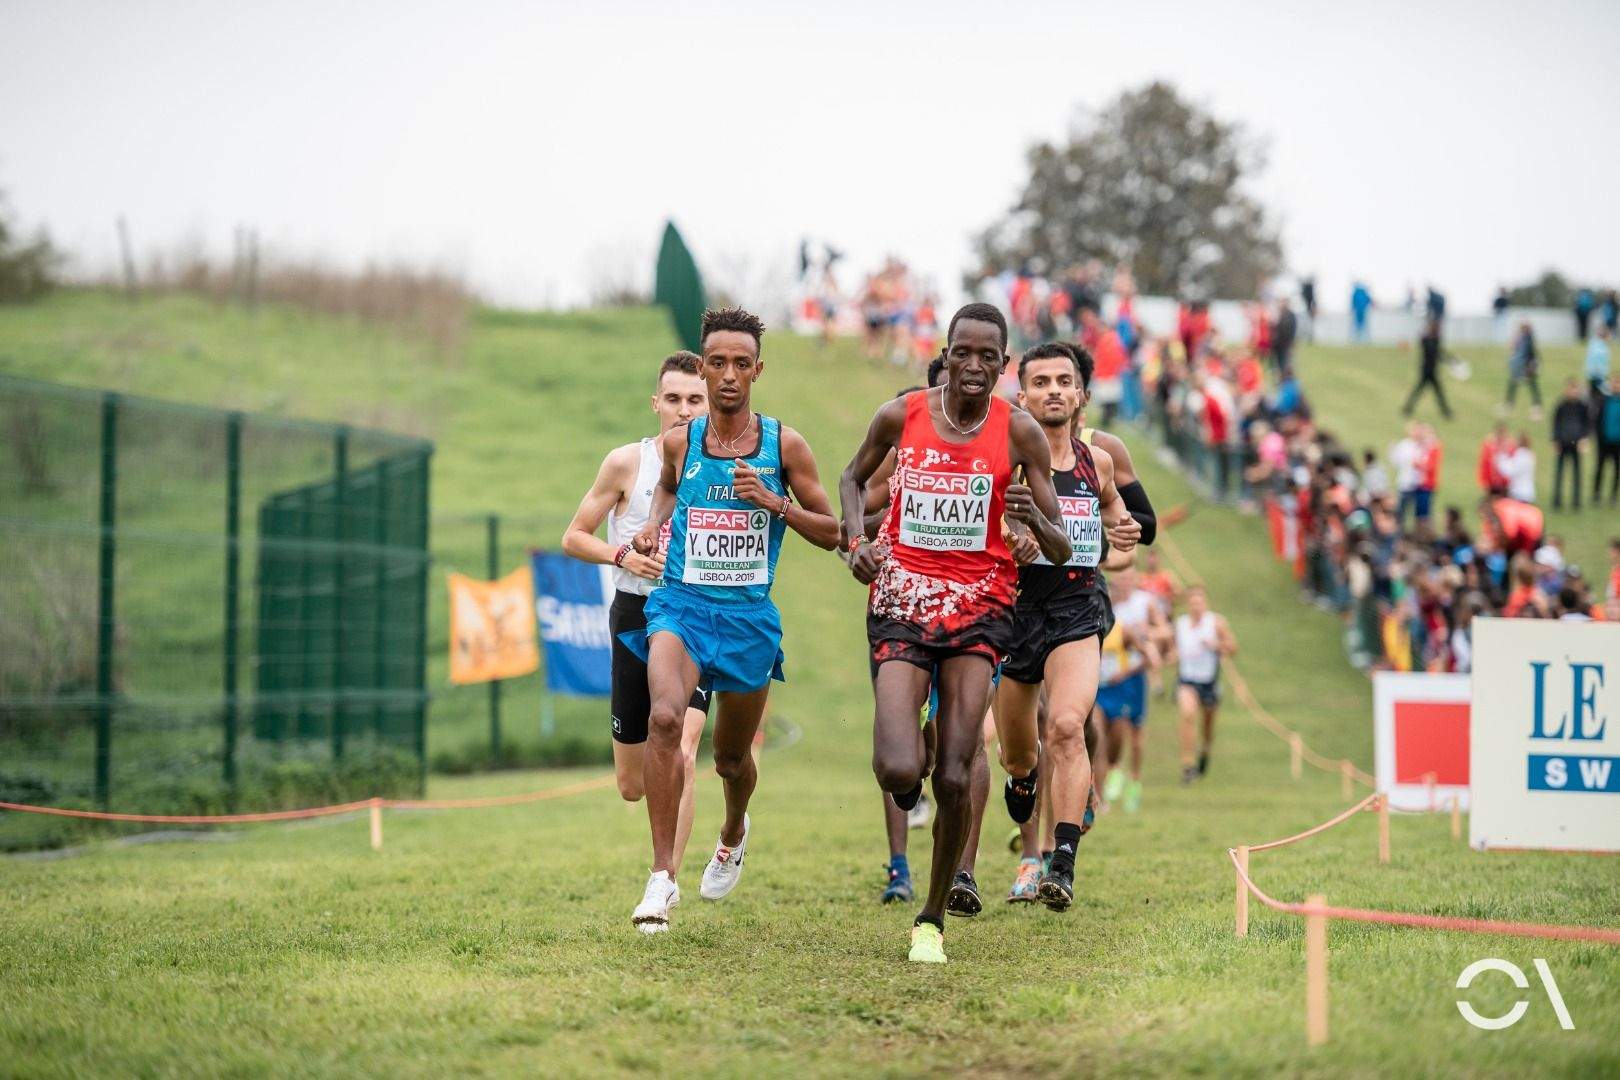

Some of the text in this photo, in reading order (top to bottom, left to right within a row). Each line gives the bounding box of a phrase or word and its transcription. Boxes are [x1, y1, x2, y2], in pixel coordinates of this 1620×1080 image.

[904, 473, 968, 494] SPAR
[706, 485, 739, 501] ITAL
[904, 494, 985, 524] Ar. KAYA
[689, 511, 747, 528] SPAR
[920, 525, 938, 533] RUN
[689, 533, 702, 557] Y.
[706, 534, 766, 558] CRIPPA
[913, 535, 973, 548] LISBOA 2019
[699, 572, 755, 582] LISBOA 2019
[1530, 661, 1607, 741] LE
